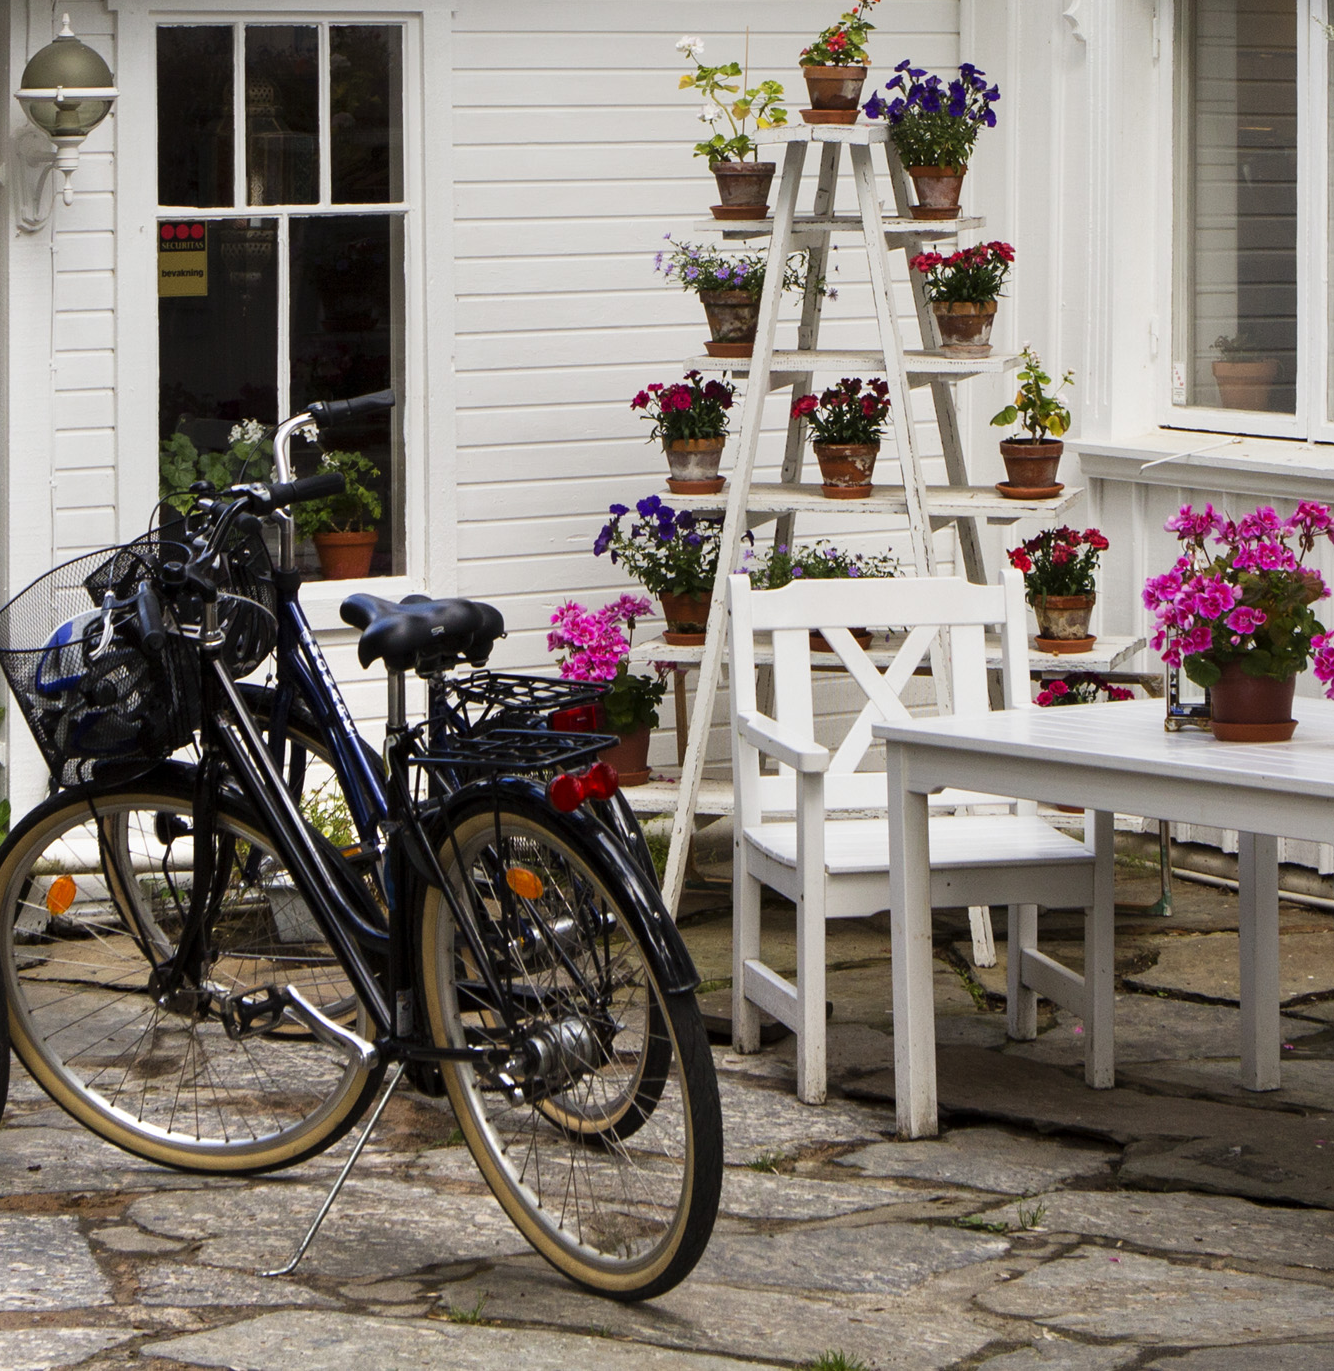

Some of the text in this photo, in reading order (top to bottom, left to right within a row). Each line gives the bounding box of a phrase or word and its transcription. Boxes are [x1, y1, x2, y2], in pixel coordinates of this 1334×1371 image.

[162, 241, 204, 249] SECURITAS
[162, 269, 204, 278] bevakning
[308, 641, 356, 734] MONARK
